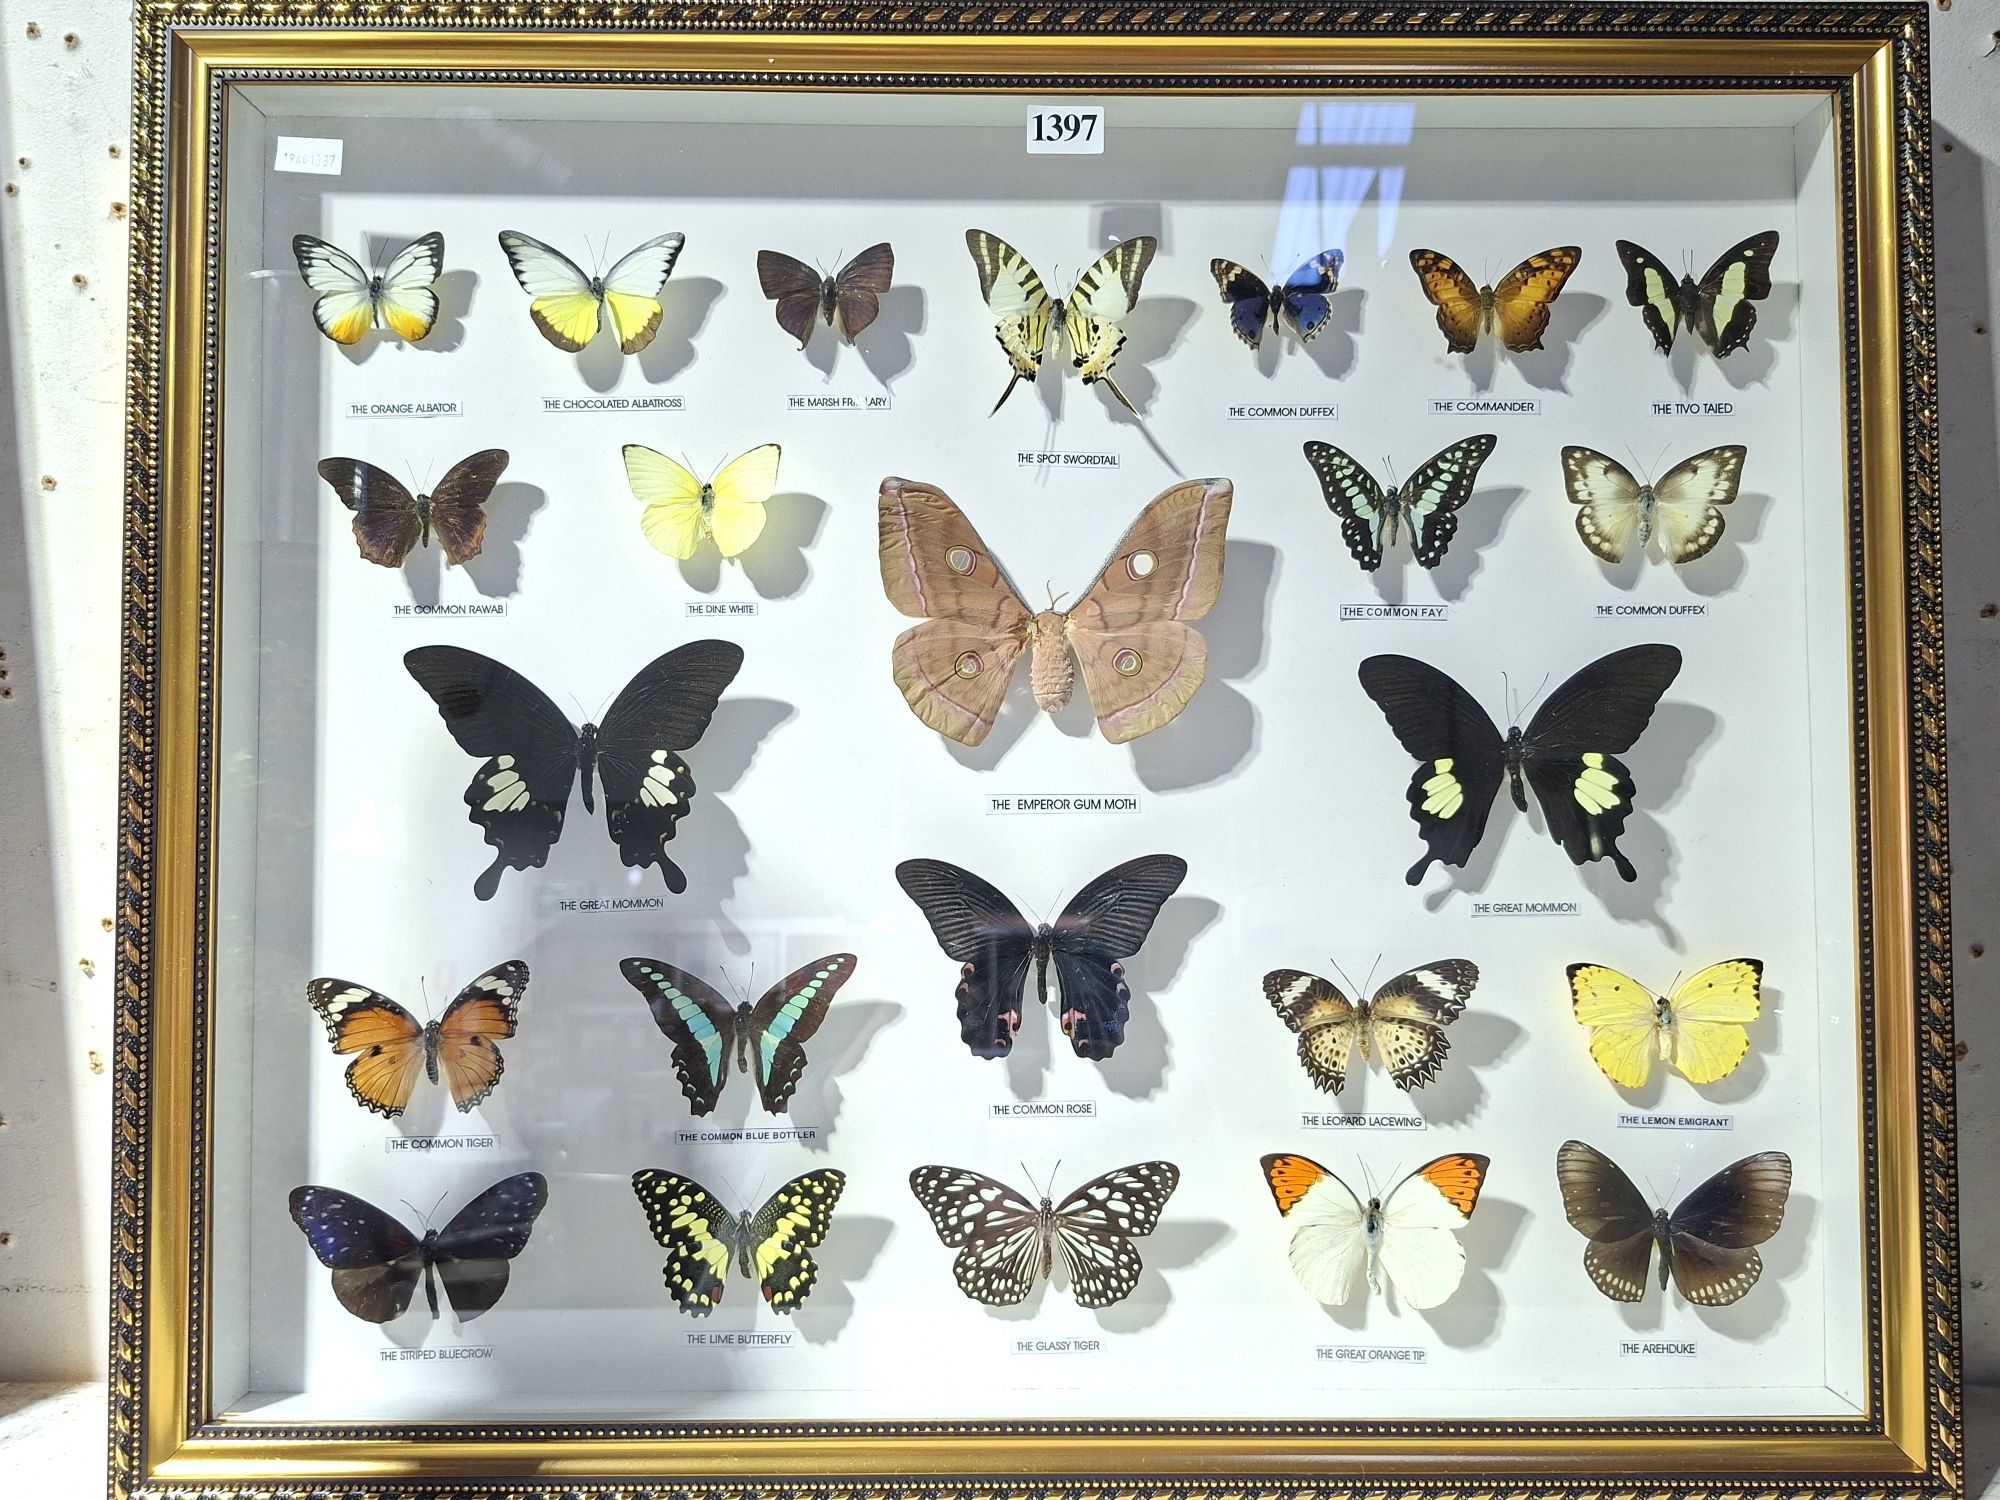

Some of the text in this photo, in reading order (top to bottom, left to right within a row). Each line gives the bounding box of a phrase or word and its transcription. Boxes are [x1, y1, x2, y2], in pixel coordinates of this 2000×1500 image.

[1032, 113, 1098, 142] 1397
[544, 398, 682, 409] THE CHOCOLATED ALBATROSS
[789, 397, 805, 407] THE
[807, 397, 839, 407] MARSH
[1434, 402, 1535, 412] THE COMMANDER
[351, 403, 457, 414] THE ORANGE ALBATOR
[1229, 407, 1335, 417] THE COMMON DUFFEX
[1652, 403, 1733, 415] THE TIVO TAIED
[1018, 453, 1118, 466] THE SPOT SWORDTAIL
[394, 604, 504, 614] THE COMMON RAWAB
[689, 604, 754, 614] THE DINE WHITE
[1343, 607, 1444, 617] THE COMMON FAY
[1596, 605, 1705, 615] THE COMMON DUFFEX
[992, 798, 1137, 810] THE EMPEROR GUM MOTH
[560, 898, 664, 911] THE GREAT MOMMON
[1473, 902, 1577, 913] THE GREAT MOMMON
[993, 1103, 1092, 1115] THE COMMON ROSE
[1302, 1115, 1422, 1127] THE LEOPARD LACEWING
[1620, 1115, 1729, 1126] THE LEMON EMIGRANT
[679, 1131, 816, 1141] THE COMMON BLUE BOTTLER
[391, 1138, 494, 1149] THE COMMON TIGER
[687, 1334, 792, 1344] THE LIME BUTTERFLY
[1016, 1340, 1100, 1351] THE GLASSY TIGER
[1622, 1343, 1639, 1354] THE
[380, 1348, 493, 1361] THE STRIPED BLUECROW
[1316, 1348, 1425, 1361] THE GREAT ORANGE TIP
